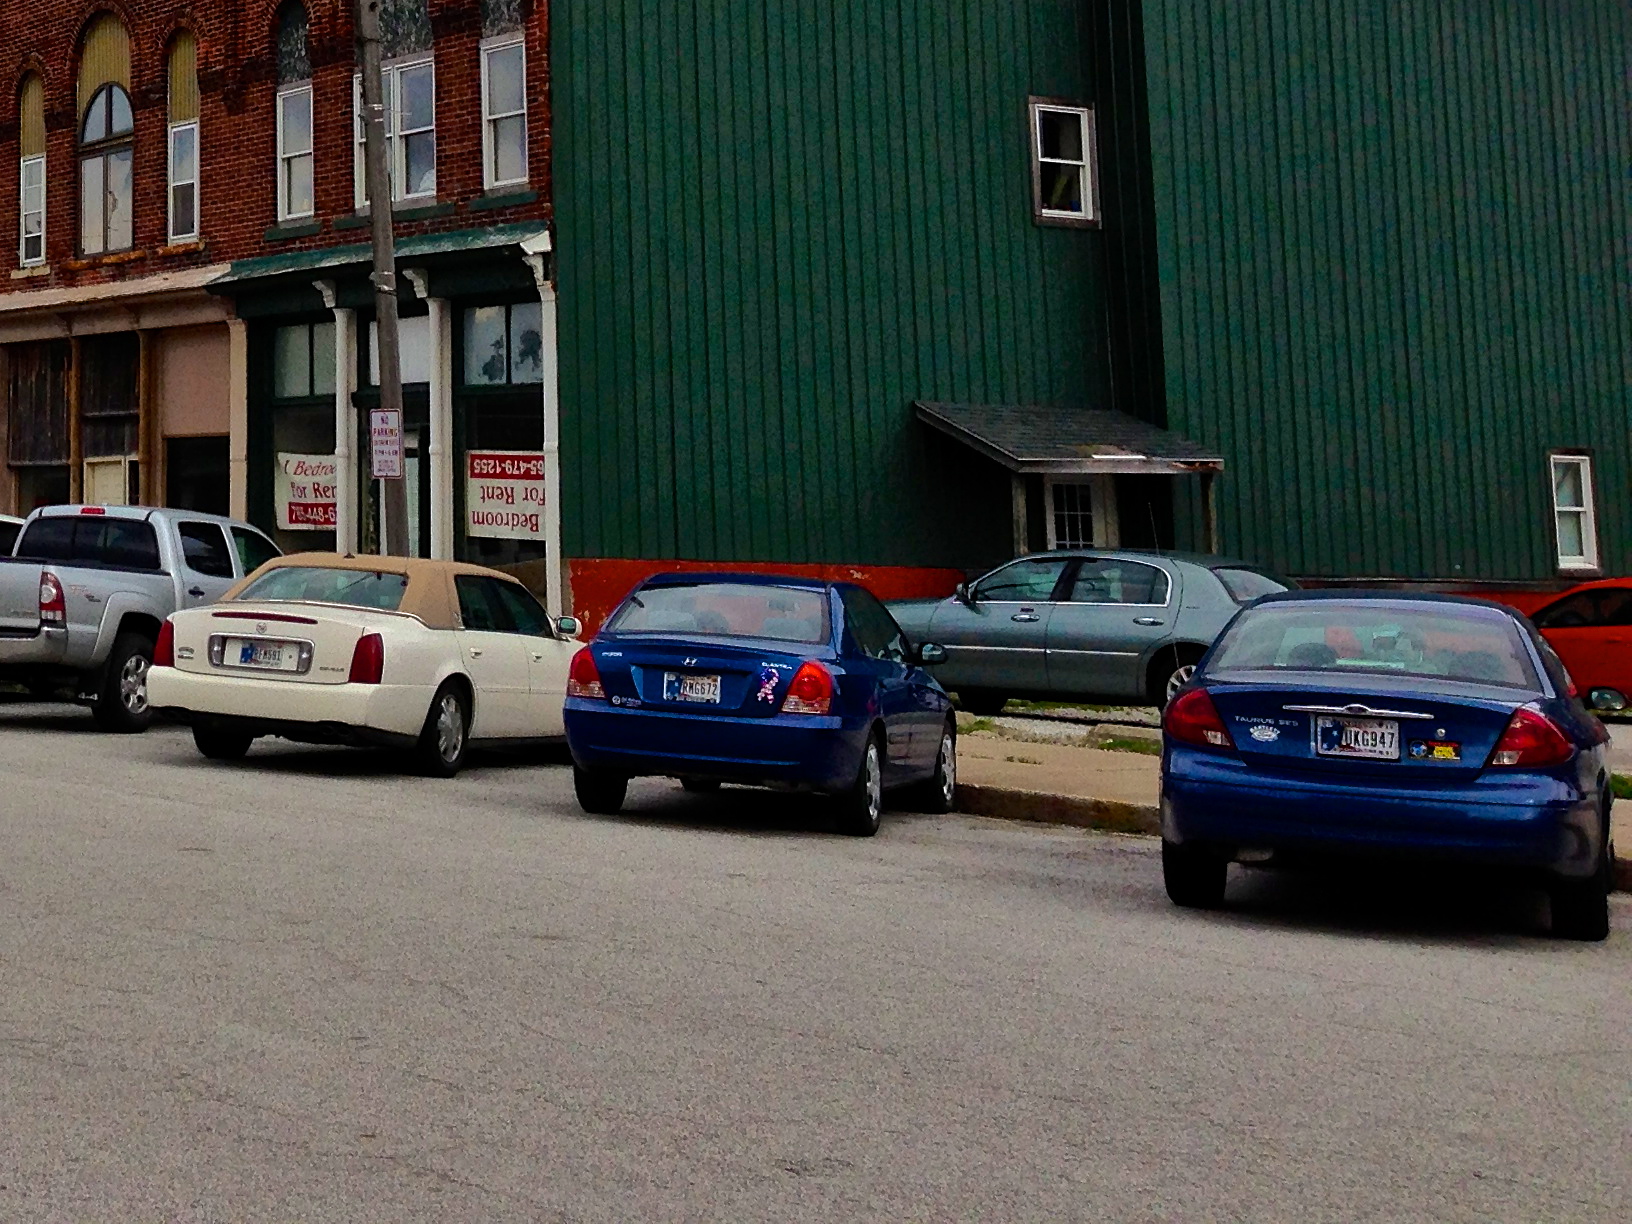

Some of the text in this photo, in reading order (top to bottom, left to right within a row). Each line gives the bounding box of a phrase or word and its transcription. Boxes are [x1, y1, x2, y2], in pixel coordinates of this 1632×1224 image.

[480, 485, 546, 506] For Rent
[471, 510, 540, 533] Bedroom
